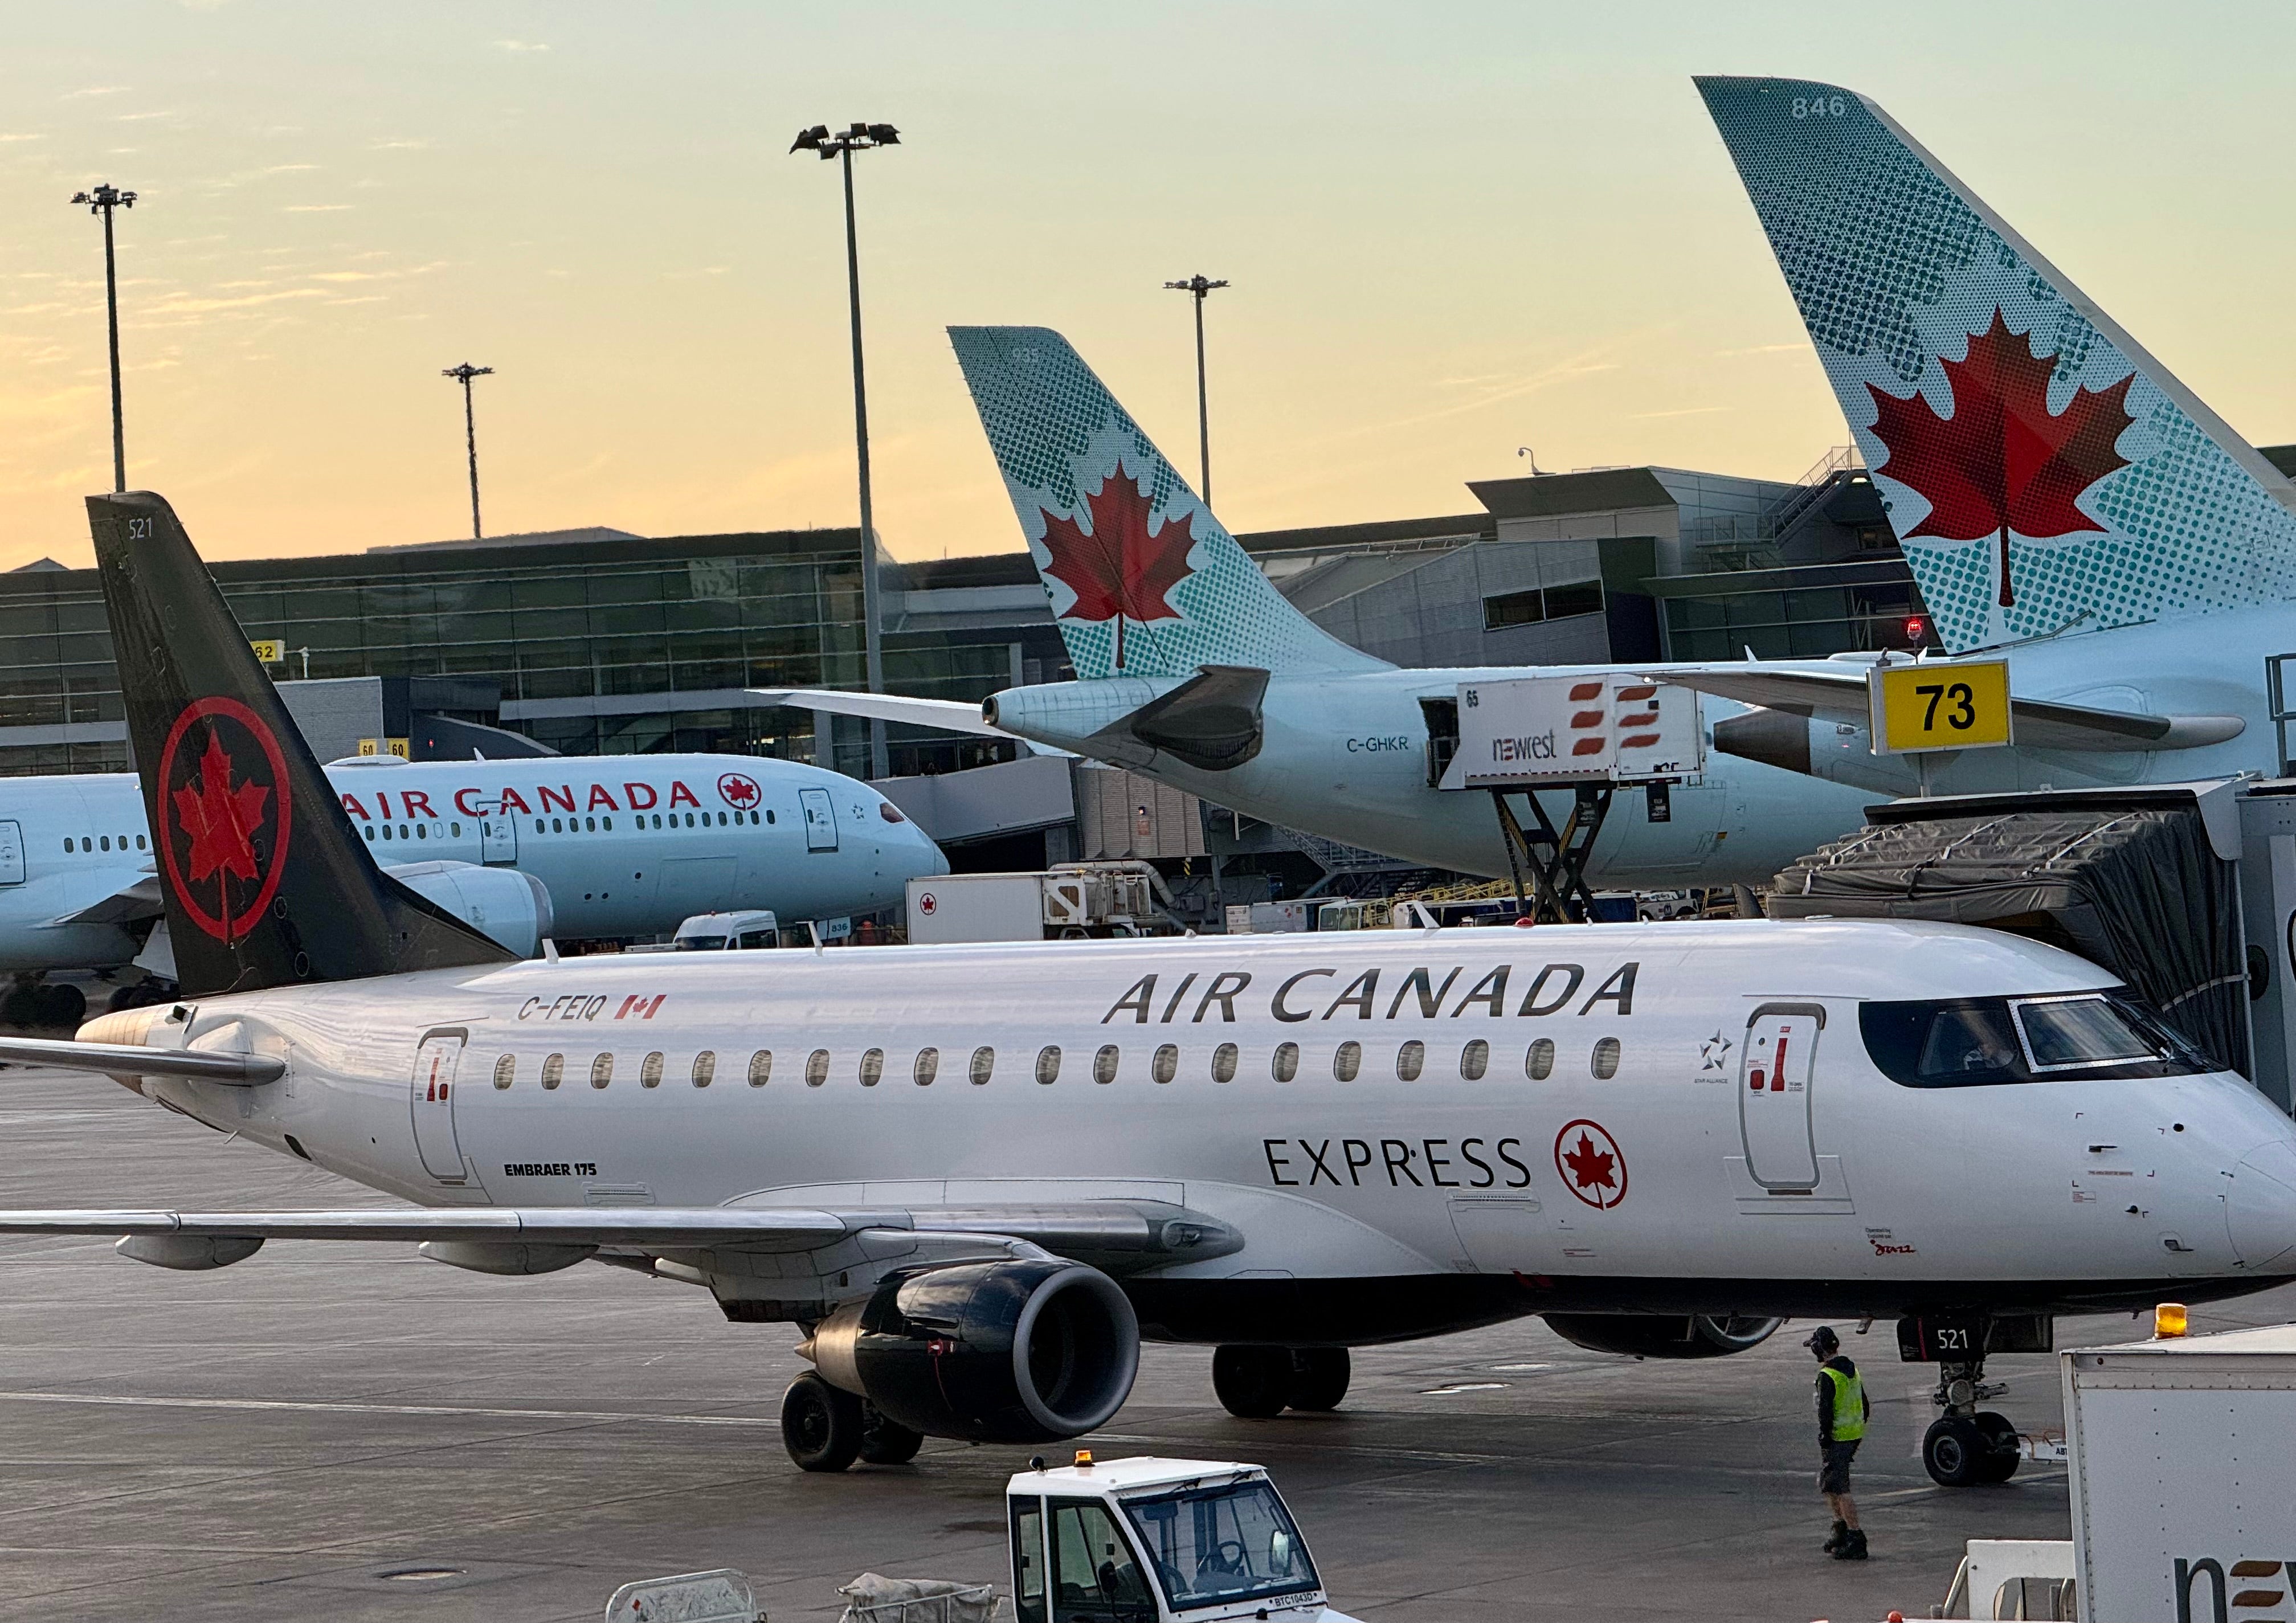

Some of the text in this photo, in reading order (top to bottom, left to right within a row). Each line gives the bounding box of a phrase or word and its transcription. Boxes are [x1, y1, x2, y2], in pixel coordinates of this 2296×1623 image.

[1792, 96, 1845, 118] 846
[129, 517, 152, 539] 521
[255, 646, 273, 658] 62
[1466, 690, 1478, 708] 65
[1915, 682, 1975, 731] 73
[363, 745, 373, 756] 60
[392, 743, 404, 756] 60
[1347, 736, 1409, 753] C-GHKR
[342, 780, 701, 820] AIR CANADA
[832, 923, 848, 932] 836
[1101, 962, 1640, 1024] AIR CANADA
[518, 995, 607, 1021] C-FEIQ
[504, 1163, 597, 1176] EMBRAER 175
[1263, 1138, 1531, 1188] EXPRESS
[1938, 1329, 1968, 1349] 521
[1274, 1592, 1313, 1606] BTC1043D
